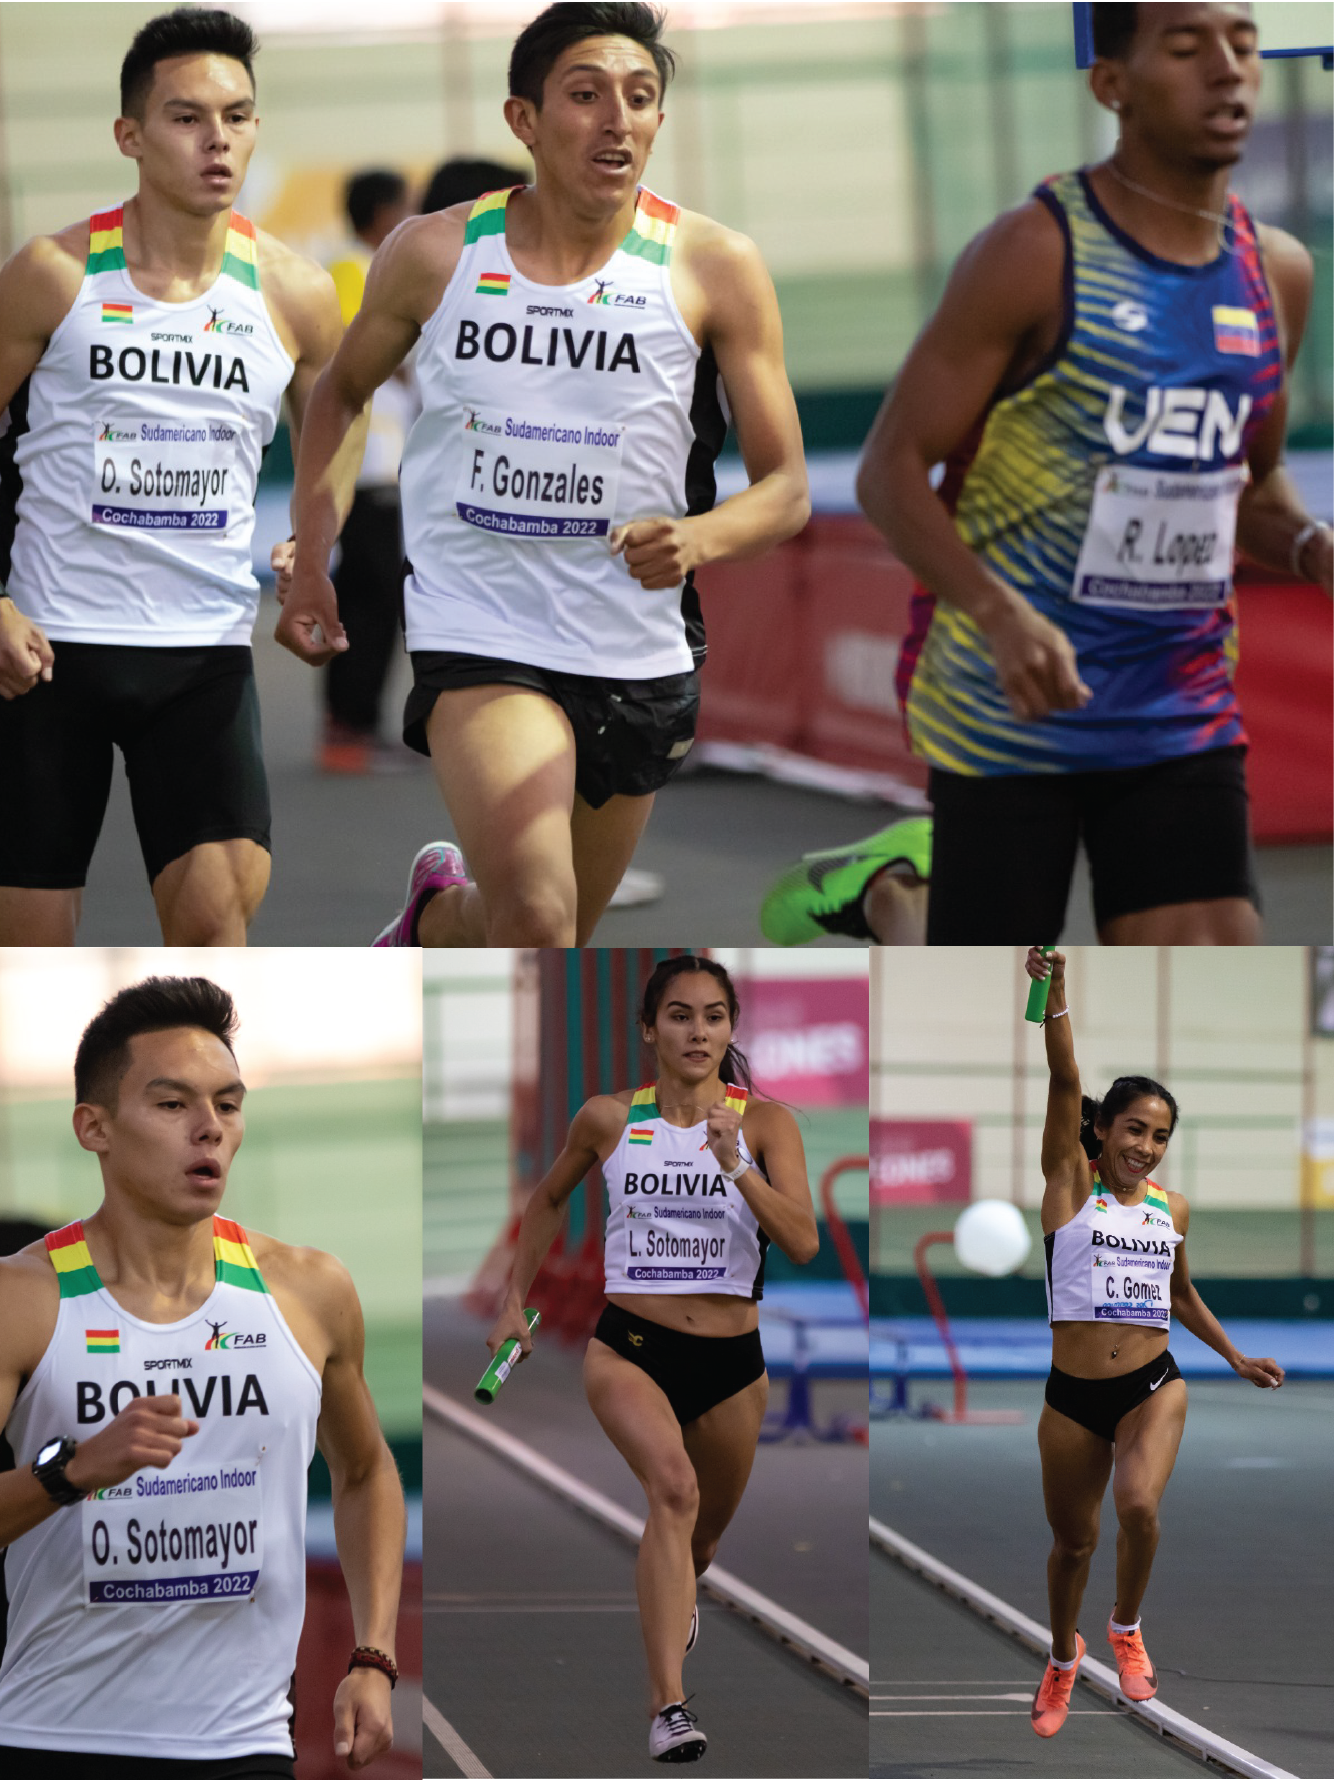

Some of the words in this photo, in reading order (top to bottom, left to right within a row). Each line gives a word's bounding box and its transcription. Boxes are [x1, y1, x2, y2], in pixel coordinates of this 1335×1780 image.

[526, 305, 574, 317] SPORTMIX
[615, 294, 646, 305] FAB
[151, 332, 193, 344] SPORTMIX
[226, 322, 253, 334] FAB
[455, 320, 640, 373] BOLIVIA
[90, 344, 250, 393] BOLIVIA
[141, 424, 206, 442] Sudamericano
[209, 426, 236, 442] Indoor
[505, 417, 582, 443] Sudamericano
[584, 424, 620, 447] Indoor
[101, 458, 120, 494] O.
[130, 459, 229, 506] Sotomayor
[471, 449, 484, 492] F.
[493, 455, 603, 505] Gonzales
[102, 509, 187, 527] Cochabamba
[191, 512, 219, 527] 2022
[466, 508, 558, 534] Cochabamba
[563, 520, 597, 535] 2022
[1153, 520, 1218, 576] Lopez
[624, 1173, 727, 1197] BOLIVIA
[654, 1206, 701, 1219] Sudamericano
[703, 1208, 725, 1219] Indoor
[629, 1230, 642, 1257] L.
[646, 1230, 725, 1265] Sotomayor
[1092, 1230, 1171, 1257] BOLIVIA
[635, 1269, 694, 1279] Cochabamba
[696, 1269, 719, 1279] 2022
[1117, 1256, 1155, 1269] Sudamericano
[1106, 1276, 1119, 1299] C.
[1123, 1276, 1162, 1301] Gomez
[1101, 1309, 1151, 1317] Cochabamba
[234, 1334, 266, 1345] FAB
[144, 1358, 192, 1370] SPORTMIX
[108, 1487, 132, 1497] FAB
[136, 1474, 217, 1497] Sudamericano
[220, 1468, 256, 1489] Indoor
[92, 1520, 118, 1566] O.
[127, 1518, 257, 1569] Sotomayor
[103, 1579, 208, 1599] Cochabamba
[213, 1576, 251, 1594] 2022
